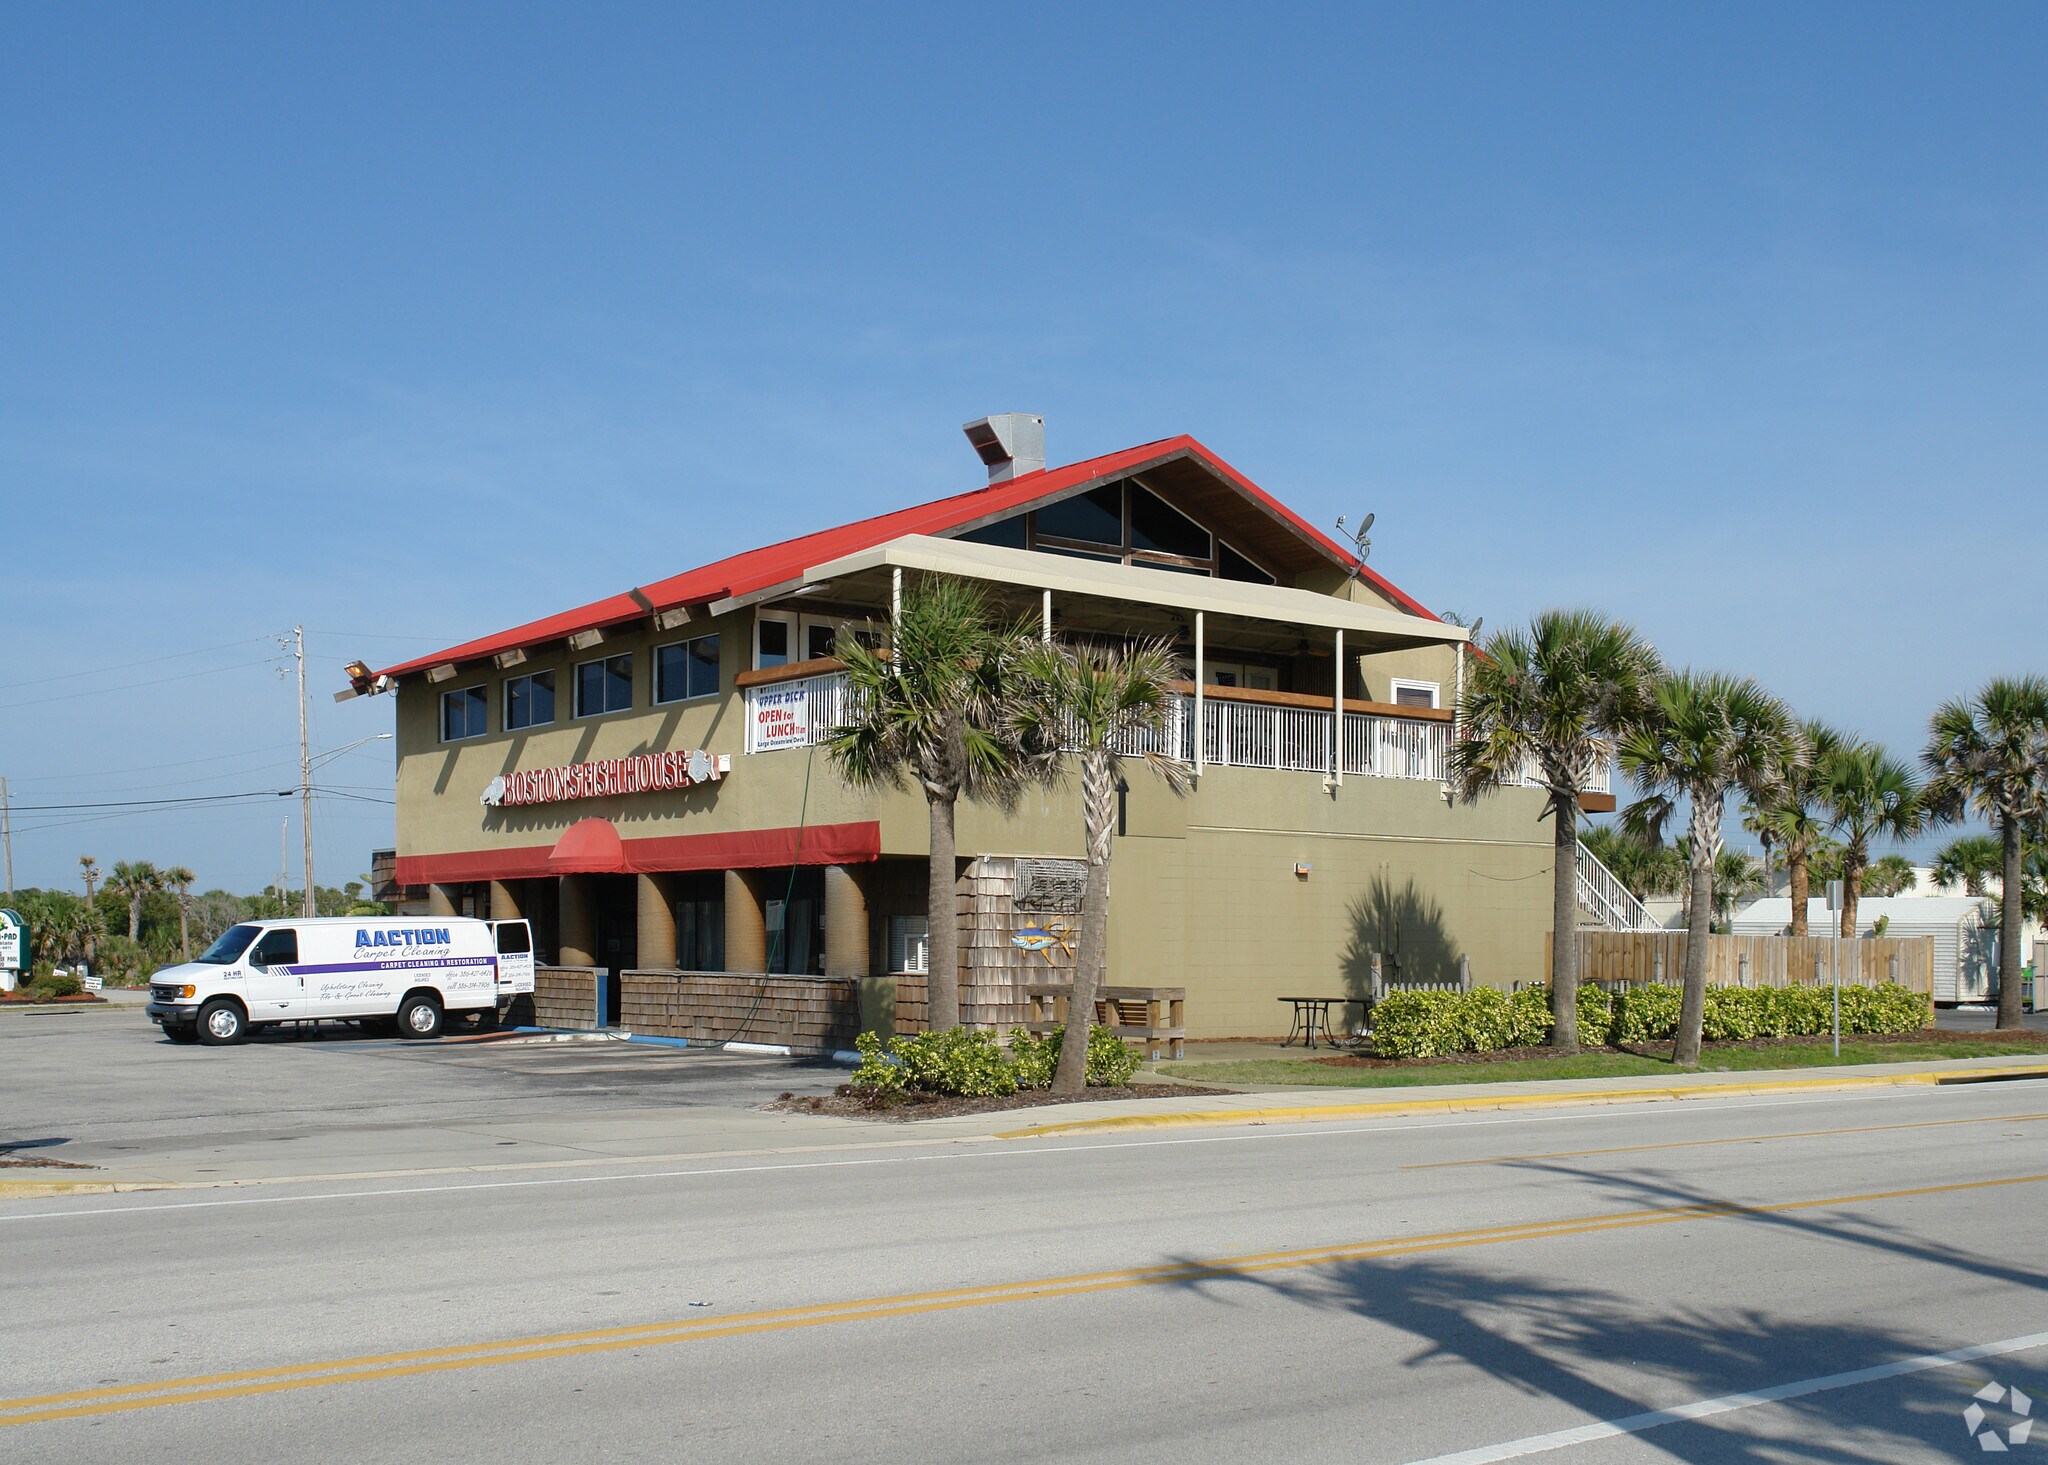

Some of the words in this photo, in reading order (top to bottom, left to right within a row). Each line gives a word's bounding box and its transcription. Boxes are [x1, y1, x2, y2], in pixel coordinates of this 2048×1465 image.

[759, 693, 782, 707] UPPER
[785, 690, 805, 704] DECK
[758, 709, 782, 723] OPEN
[783, 712, 794, 720] for
[766, 723, 795, 738] LUNCH
[624, 750, 691, 793] HOUSE
[355, 929, 451, 948] AACTION
[353, 947, 396, 962] Carpet
[401, 945, 450, 958] Cleaning
[380, 961, 406, 969] CARPET
[407, 959, 439, 967] CLEANING
[448, 957, 488, 965] RESTORATION
